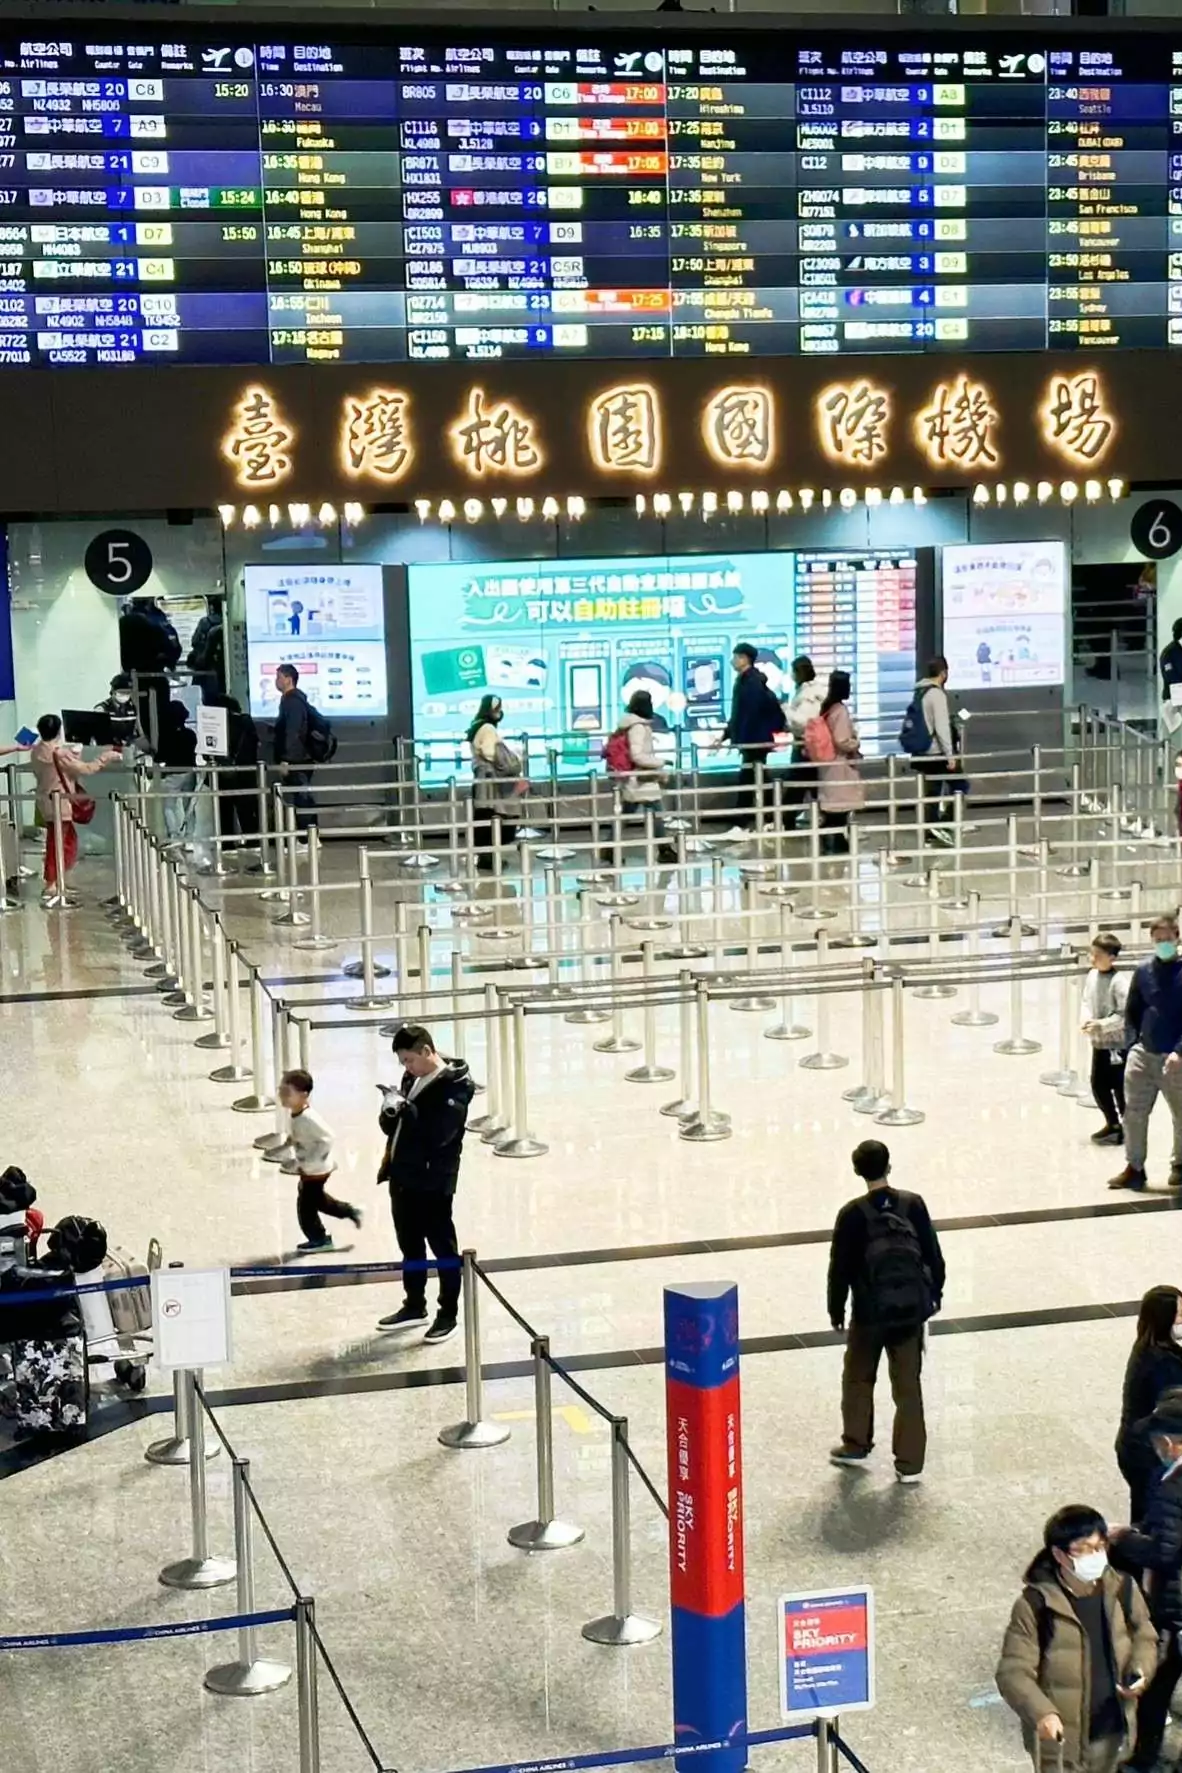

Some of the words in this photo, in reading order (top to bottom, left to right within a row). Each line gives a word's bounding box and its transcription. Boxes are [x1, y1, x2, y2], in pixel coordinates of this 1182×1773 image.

[294, 46, 332, 60] 目的地
[105, 83, 125, 96] 20
[136, 83, 155, 96] C8
[214, 83, 249, 97] 15:20
[260, 85, 293, 97] 16:30
[524, 87, 542, 99] 20
[552, 87, 570, 98] C6
[626, 86, 658, 100] 17:00
[667, 87, 699, 99] 17:20
[917, 89, 927, 101] 9
[1049, 88, 1078, 99] 23:40
[700, 104, 744, 114] Hiroshima
[1079, 104, 1111, 114] Seattle
[112, 119, 122, 132] 7
[262, 121, 295, 133] 16:30
[669, 121, 700, 134] 17:25
[918, 123, 928, 135] 2
[110, 155, 128, 168] 21
[140, 156, 159, 168] C9
[263, 156, 298, 169] 16:35
[526, 157, 545, 170] 20
[670, 156, 700, 169] 17:35
[918, 156, 928, 169] 9
[701, 173, 720, 183] New
[723, 173, 742, 183] York
[117, 191, 127, 203] 7
[221, 190, 255, 204] 15:24
[265, 191, 299, 203] 16:40
[528, 191, 546, 204] 26
[918, 190, 928, 202] 5
[300, 209, 321, 220] Hong
[325, 209, 347, 220] Kong
[1079, 204, 1094, 214] San
[1096, 204, 1138, 214] Francisco
[118, 228, 128, 241] 1
[144, 228, 163, 240] D7
[222, 226, 256, 240] 15:50
[267, 226, 300, 239] 16:45
[533, 227, 542, 239] 7
[556, 226, 575, 239] D9
[630, 226, 661, 239] 16:35
[671, 225, 702, 237] 17:35
[302, 243, 344, 254] Shanghai
[703, 241, 747, 251] Singapore
[269, 262, 302, 274] 16:50
[530, 261, 546, 273] 21
[552, 261, 581, 273] C5R
[672, 258, 703, 271] 17:50
[919, 257, 929, 269] 3
[1049, 254, 1078, 267] 23:50
[116, 263, 135, 276] 21
[146, 263, 165, 275] C4
[1098, 270, 1130, 281] Angeles
[531, 296, 549, 309] 23
[919, 291, 930, 303] 4
[118, 299, 137, 311] 20
[143, 298, 172, 311] C10
[916, 323, 933, 336] 20
[120, 334, 138, 346] 21
[150, 334, 169, 346] C2
[222, 378, 1118, 486] 臺灣桃園國際機場
[218, 502, 366, 528] TAIWAN
[414, 496, 586, 525] TAOYUAN
[635, 486, 928, 519] INTERNATIONAL
[972, 477, 1124, 506] AIRPORT
[1148, 511, 1171, 548] 6
[107, 542, 133, 583] 5
[683, 1492, 695, 1531] SKY
[676, 1490, 687, 1574] PRIORITY
[174, 1625, 200, 1634] AIRLINES
[793, 1628, 820, 1641] SKY
[23, 1638, 50, 1647] AIRLINES
[793, 1632, 858, 1650] PRIORITY
[695, 1742, 722, 1752] AIRLINES
[539, 1762, 567, 1772] AIRLINES
